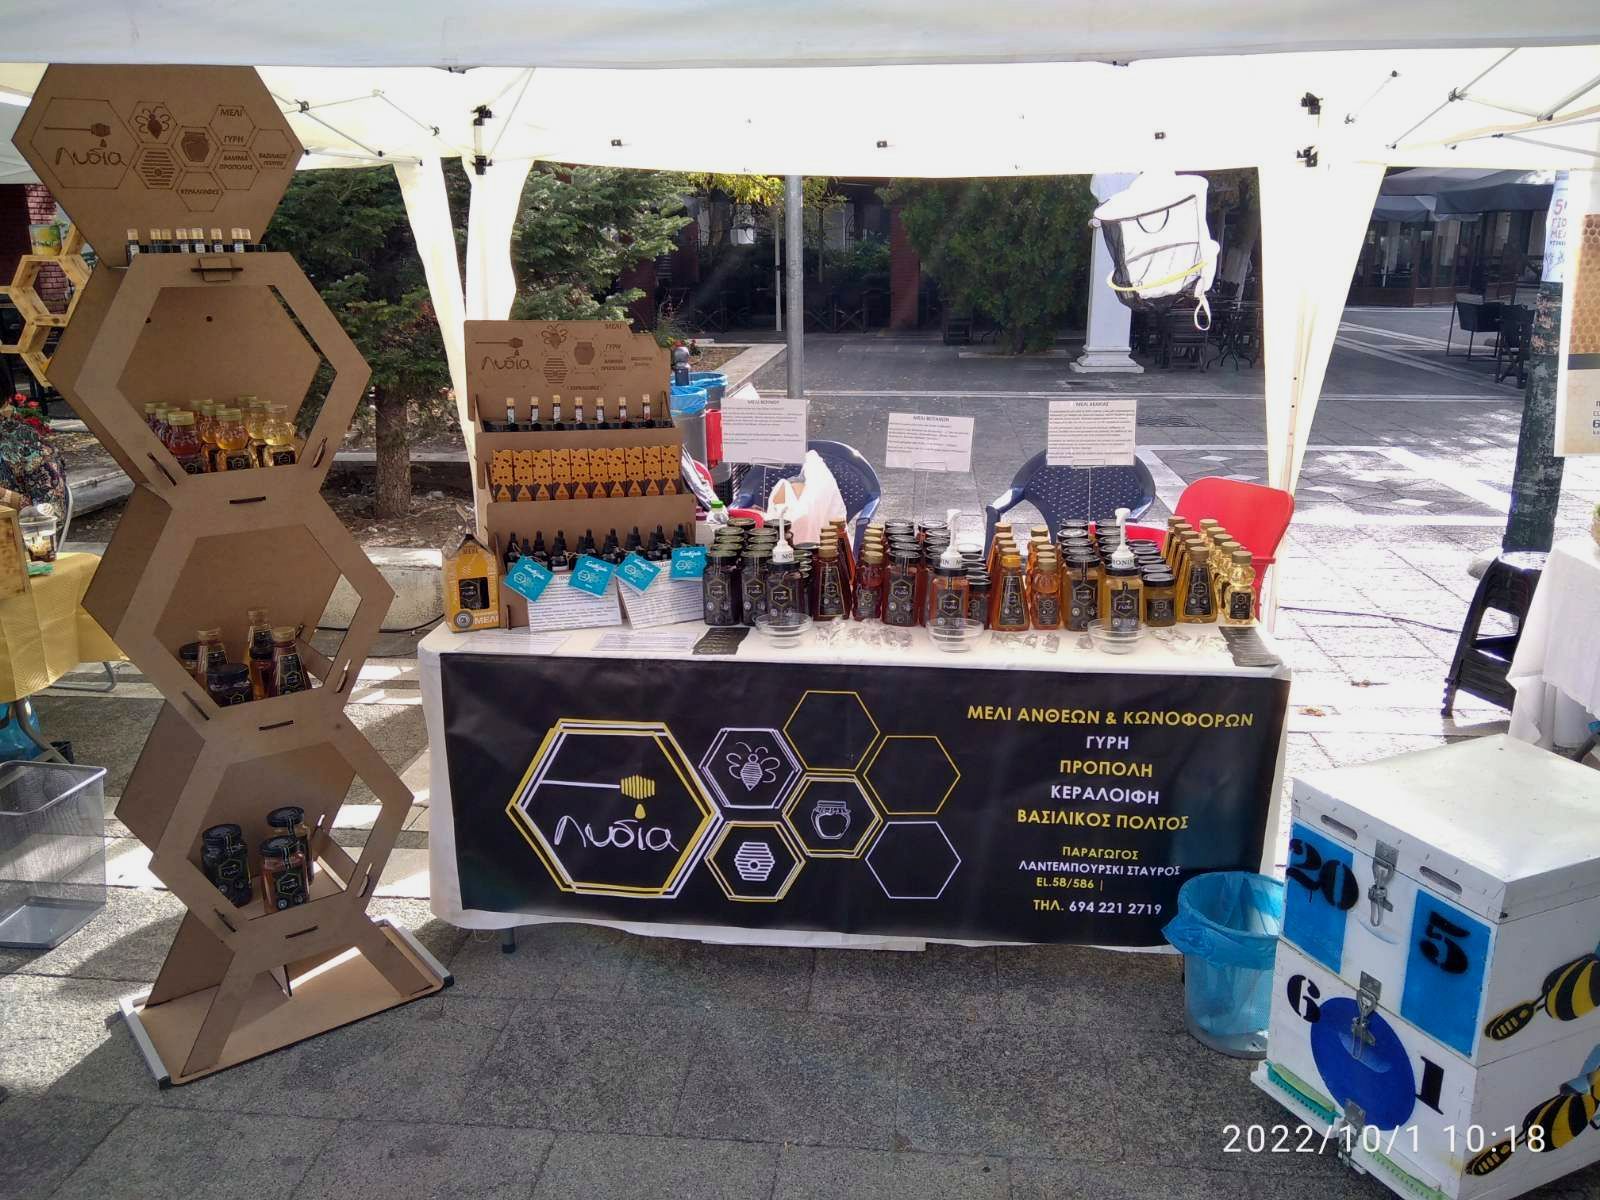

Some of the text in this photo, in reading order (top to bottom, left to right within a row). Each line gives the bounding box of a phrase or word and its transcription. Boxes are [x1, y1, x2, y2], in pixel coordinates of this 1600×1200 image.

[967, 704, 1254, 728] ΜΕΛΙ ΑΝΘΕΩΝ & ΚΩΝΟΦΟΡΩΝ
[1086, 735, 1129, 750] ΓΥΡΗ
[1060, 759, 1153, 778] ΠΡΟΠΟΛΗ
[1050, 784, 1160, 805] ΚΕΡΑΛΟΙΦΗ
[1017, 808, 1189, 831] ΒΑΣΙΛΙΚΟΣ ΠΟΛΤΟΣ
[1062, 846, 1139, 861] ΠΑΡΑΓΩΓΟΣ
[1018, 859, 1181, 877] ΛΑΝΤΕΜΠΟΥΡΣΚΙ ΣΤΑΥΡΟΣ
[1286, 838, 1360, 911] 20
[1036, 876, 1095, 889] EL.58/586
[1033, 899, 1163, 916] ΤΗΛ. 694 221 2719
[1419, 910, 1471, 975] 5
[1287, 974, 1321, 1024] 6
[1415, 1055, 1445, 1115] 1
